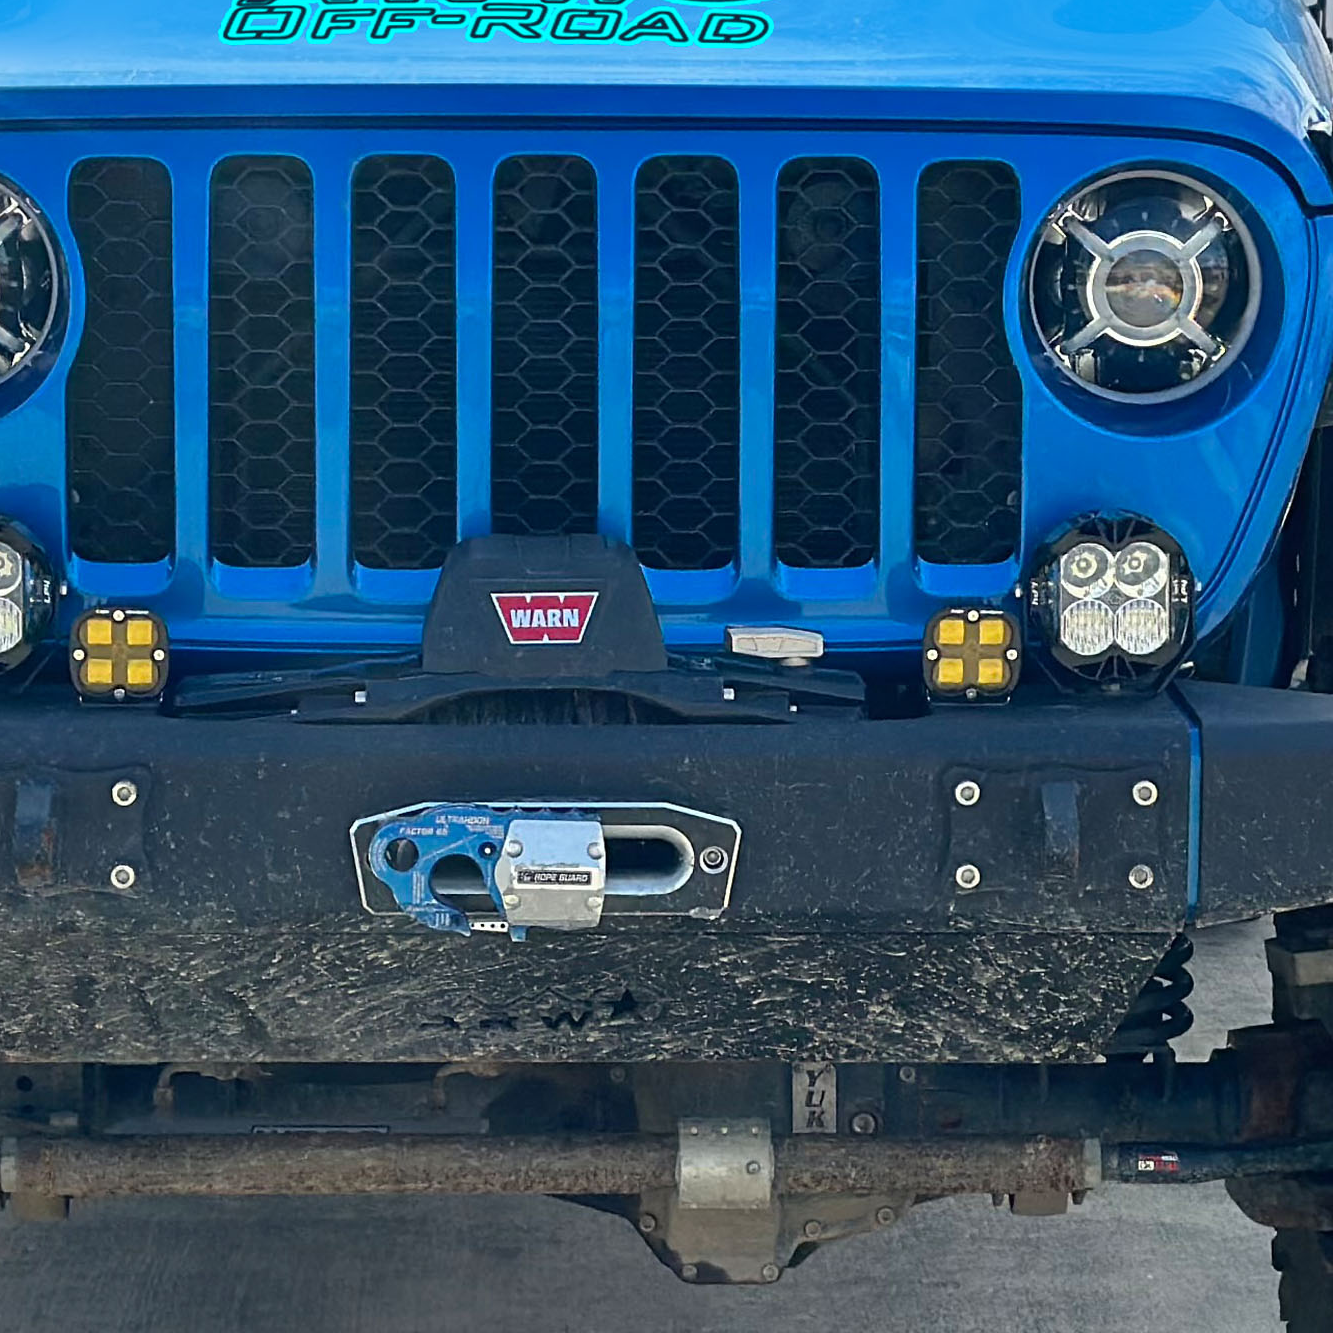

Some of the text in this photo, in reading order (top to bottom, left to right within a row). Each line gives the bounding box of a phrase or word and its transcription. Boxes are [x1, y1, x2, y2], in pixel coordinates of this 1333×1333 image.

[220, 1, 774, 47] OFF-ROAD
[509, 608, 580, 629] WARN
[804, 1068, 826, 1129] YUK
